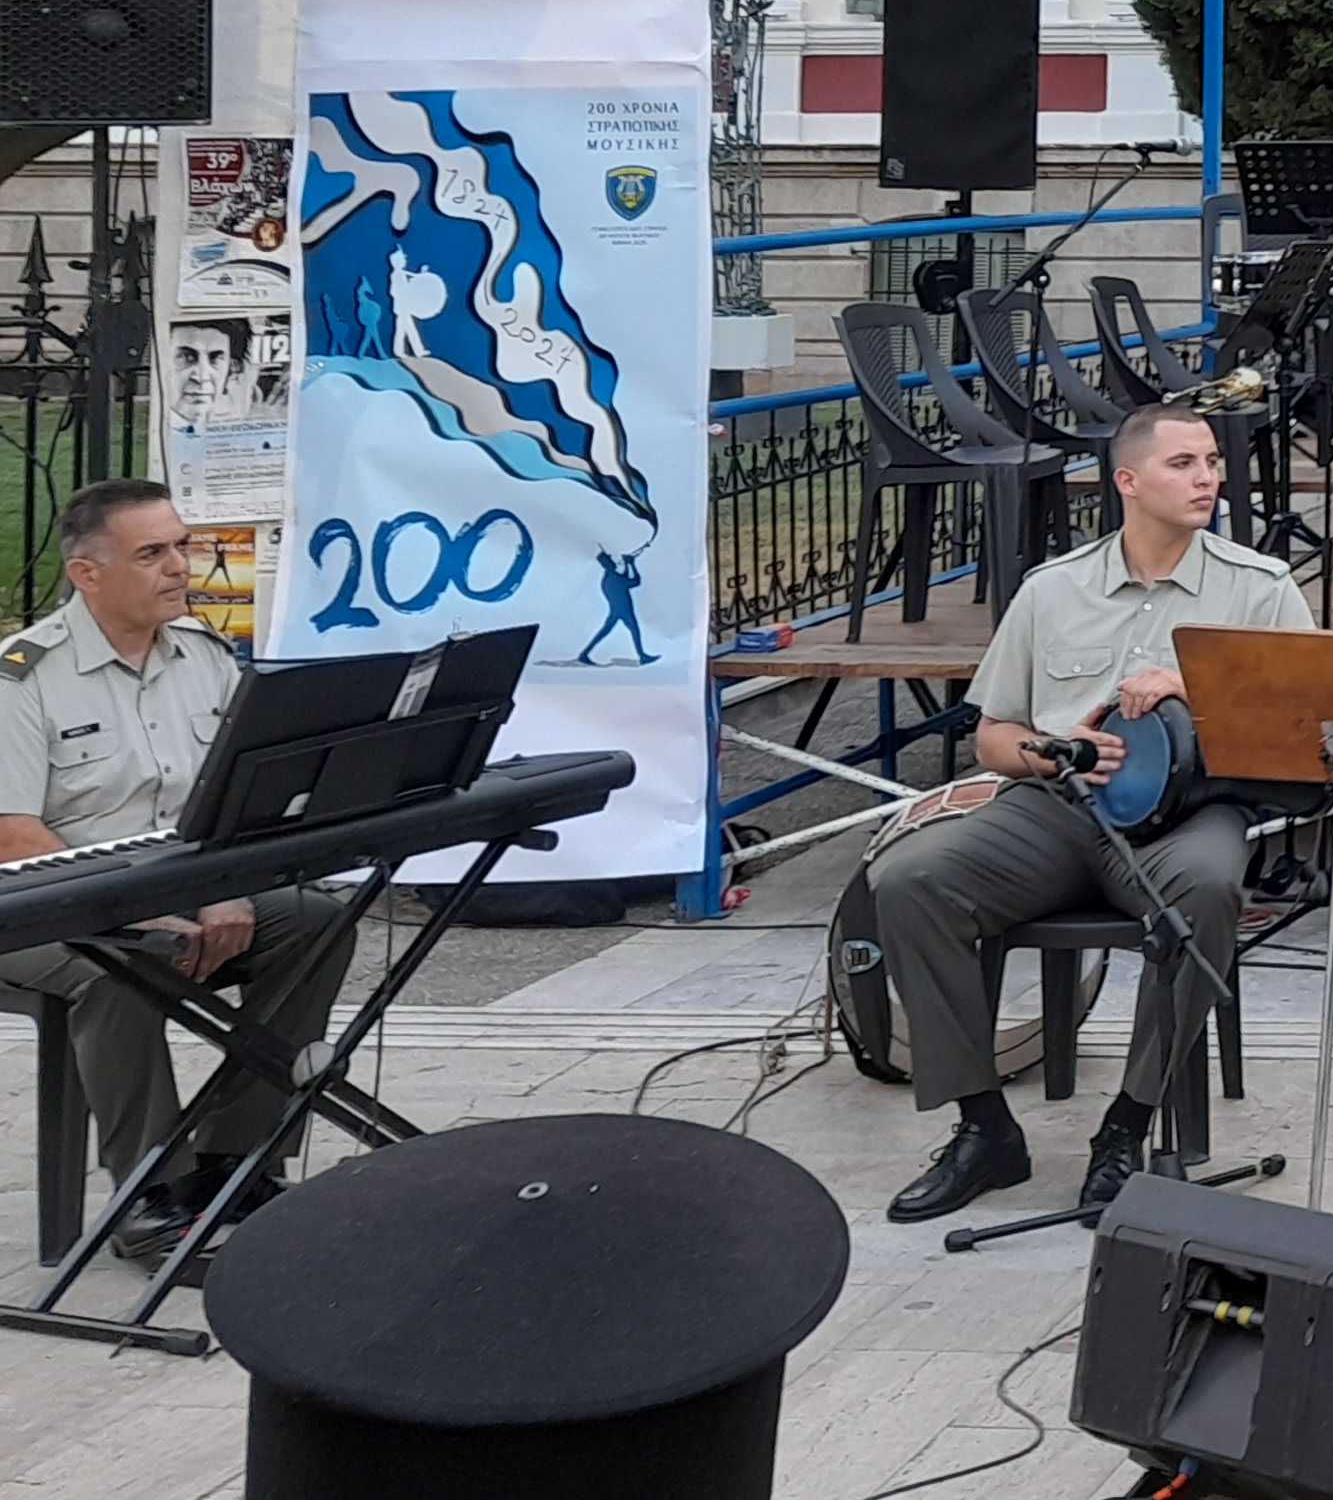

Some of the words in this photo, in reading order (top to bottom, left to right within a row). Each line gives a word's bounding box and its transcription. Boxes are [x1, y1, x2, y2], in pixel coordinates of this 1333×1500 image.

[587, 102, 616, 115] 200
[622, 101, 680, 114] ΧΡΟΝΙΑ
[586, 138, 680, 151] ΜΟΥΣΙΚΗΣ
[500, 307, 573, 375] 2024
[308, 508, 534, 633] 200
